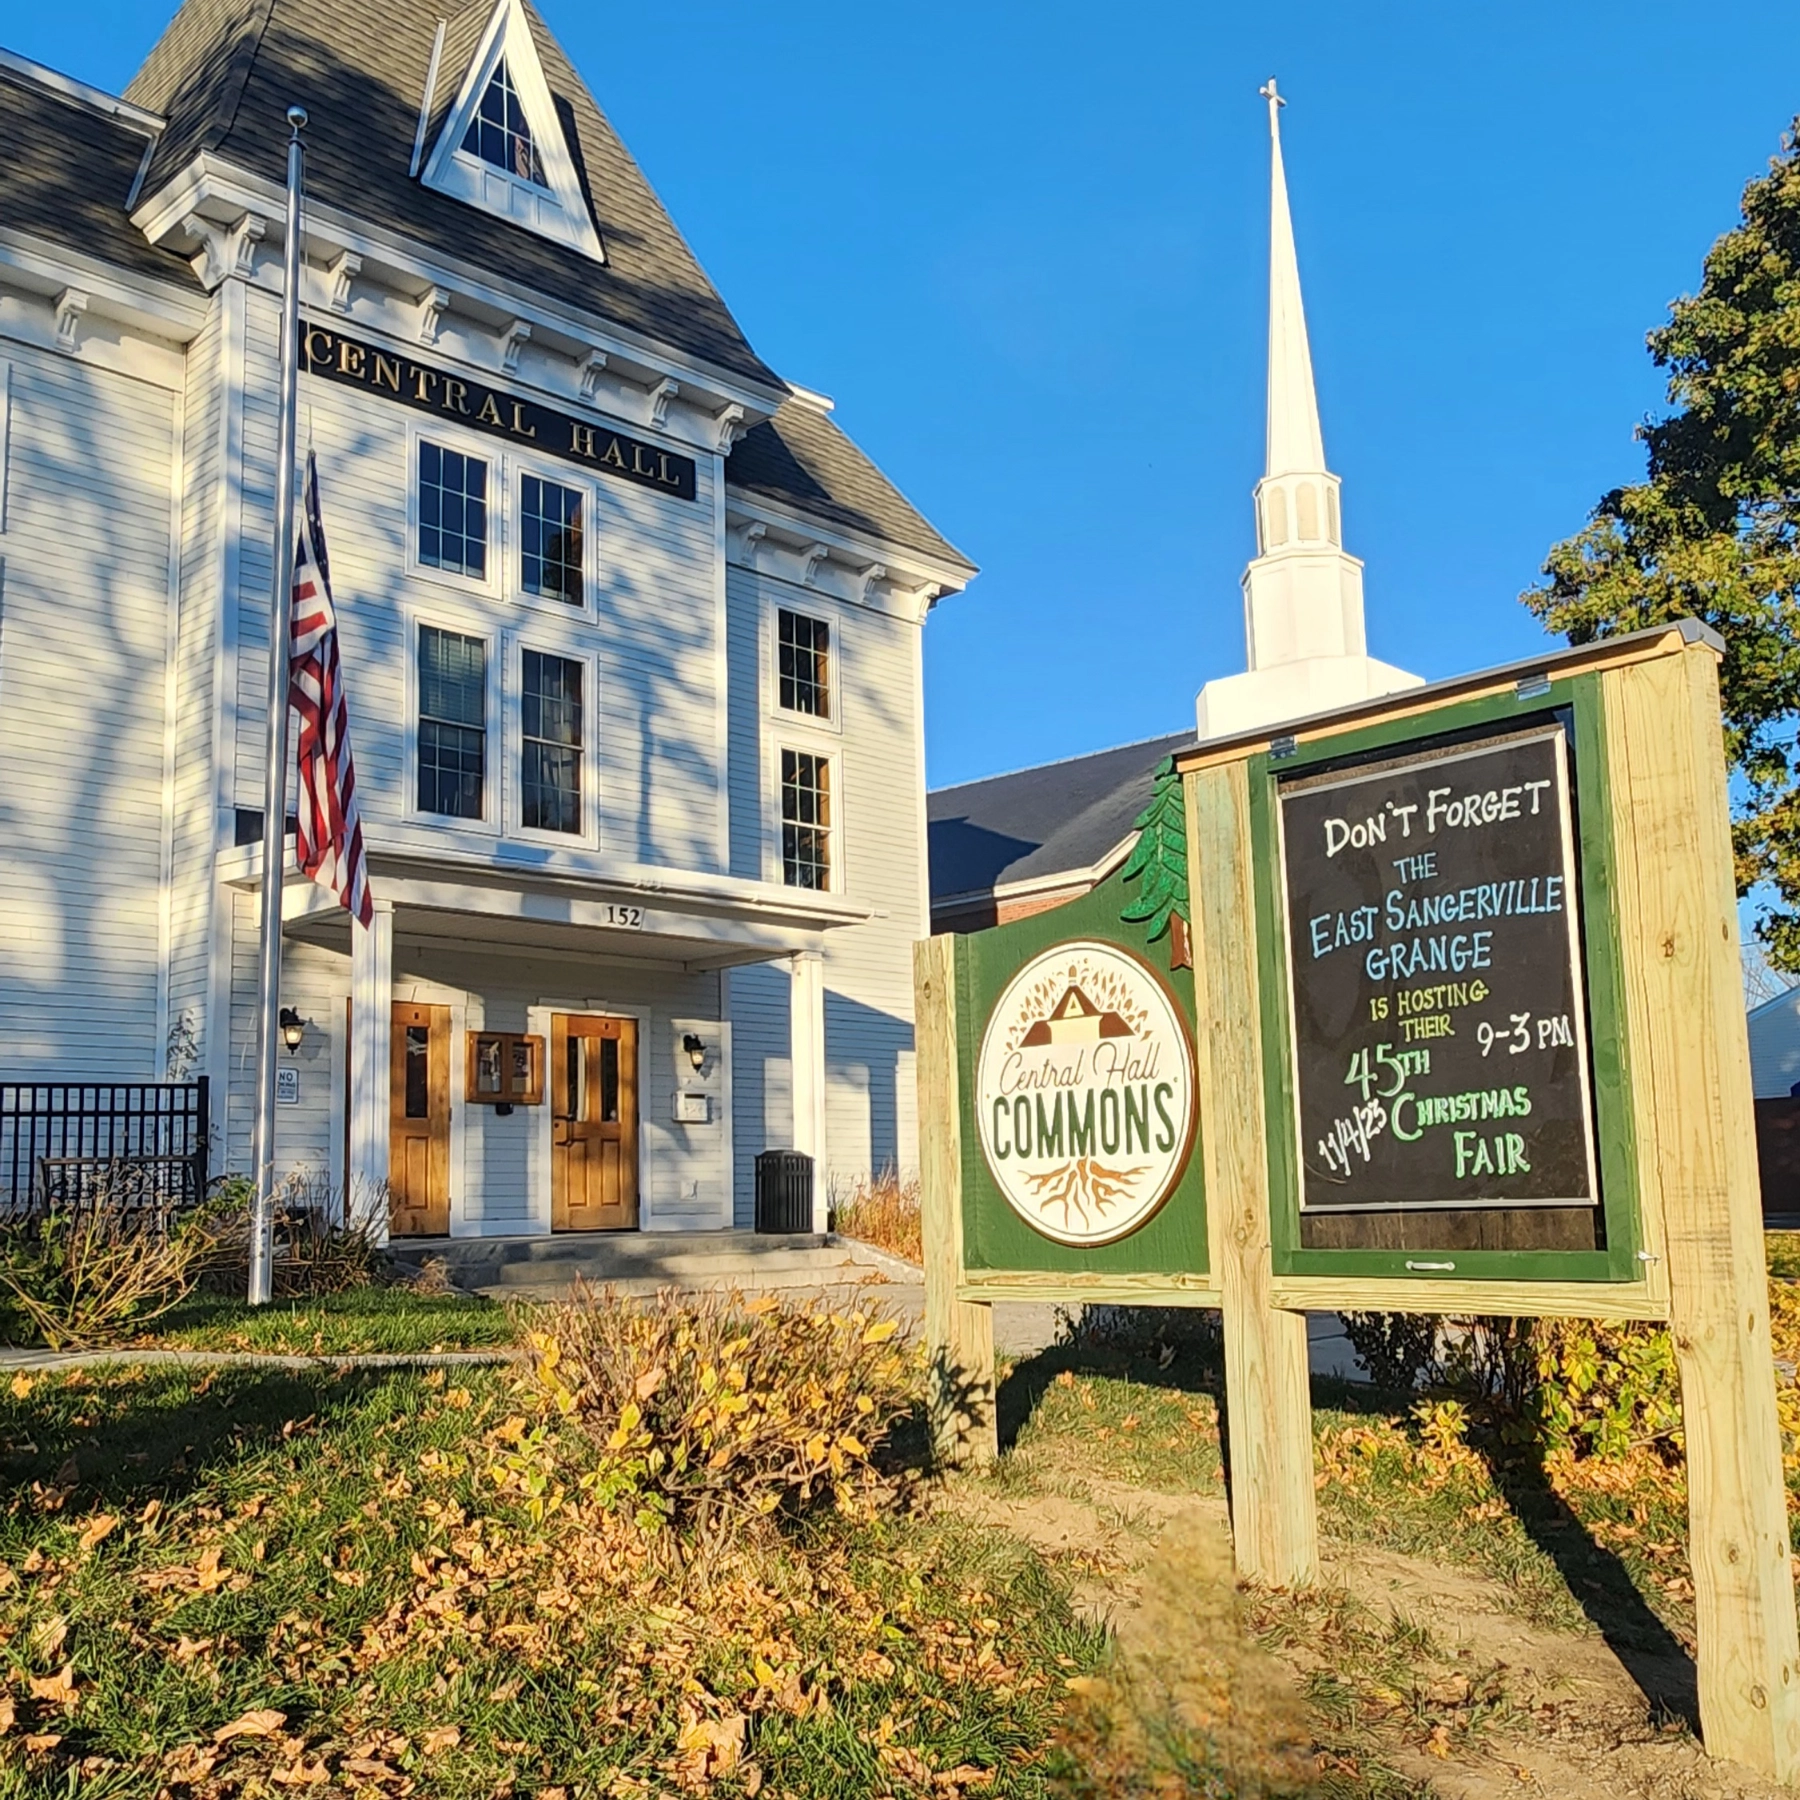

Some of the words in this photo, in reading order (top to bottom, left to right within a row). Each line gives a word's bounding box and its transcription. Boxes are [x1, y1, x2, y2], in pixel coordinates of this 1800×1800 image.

[304, 330, 536, 438] CENTRAL
[569, 421, 680, 486] HALL
[1323, 800, 1418, 858] DON'T
[1426, 780, 1551, 834] FORGET
[1393, 852, 1438, 884] THE
[607, 905, 640, 927] 152
[1310, 905, 1379, 959] EAST
[1386, 876, 1563, 932] SANGERVILLE
[1365, 930, 1493, 981] GRANGE
[1369, 997, 1389, 1021] IS
[1397, 979, 1489, 1015] HOSTING
[1399, 1014, 1455, 1042] THEIR
[1476, 1011, 1531, 1057] 9-3
[1537, 1015, 1574, 1049] PM
[1000, 1048, 1084, 1096] Central
[1092, 1041, 1161, 1089] Hall
[1343, 1043, 1431, 1101] 45TH
[993, 1082, 1176, 1160] COMMONS
[1318, 1098, 1387, 1176] 11/4/23
[1390, 1086, 1531, 1141] CHRISTMAS
[1454, 1130, 1531, 1180] FAIR
